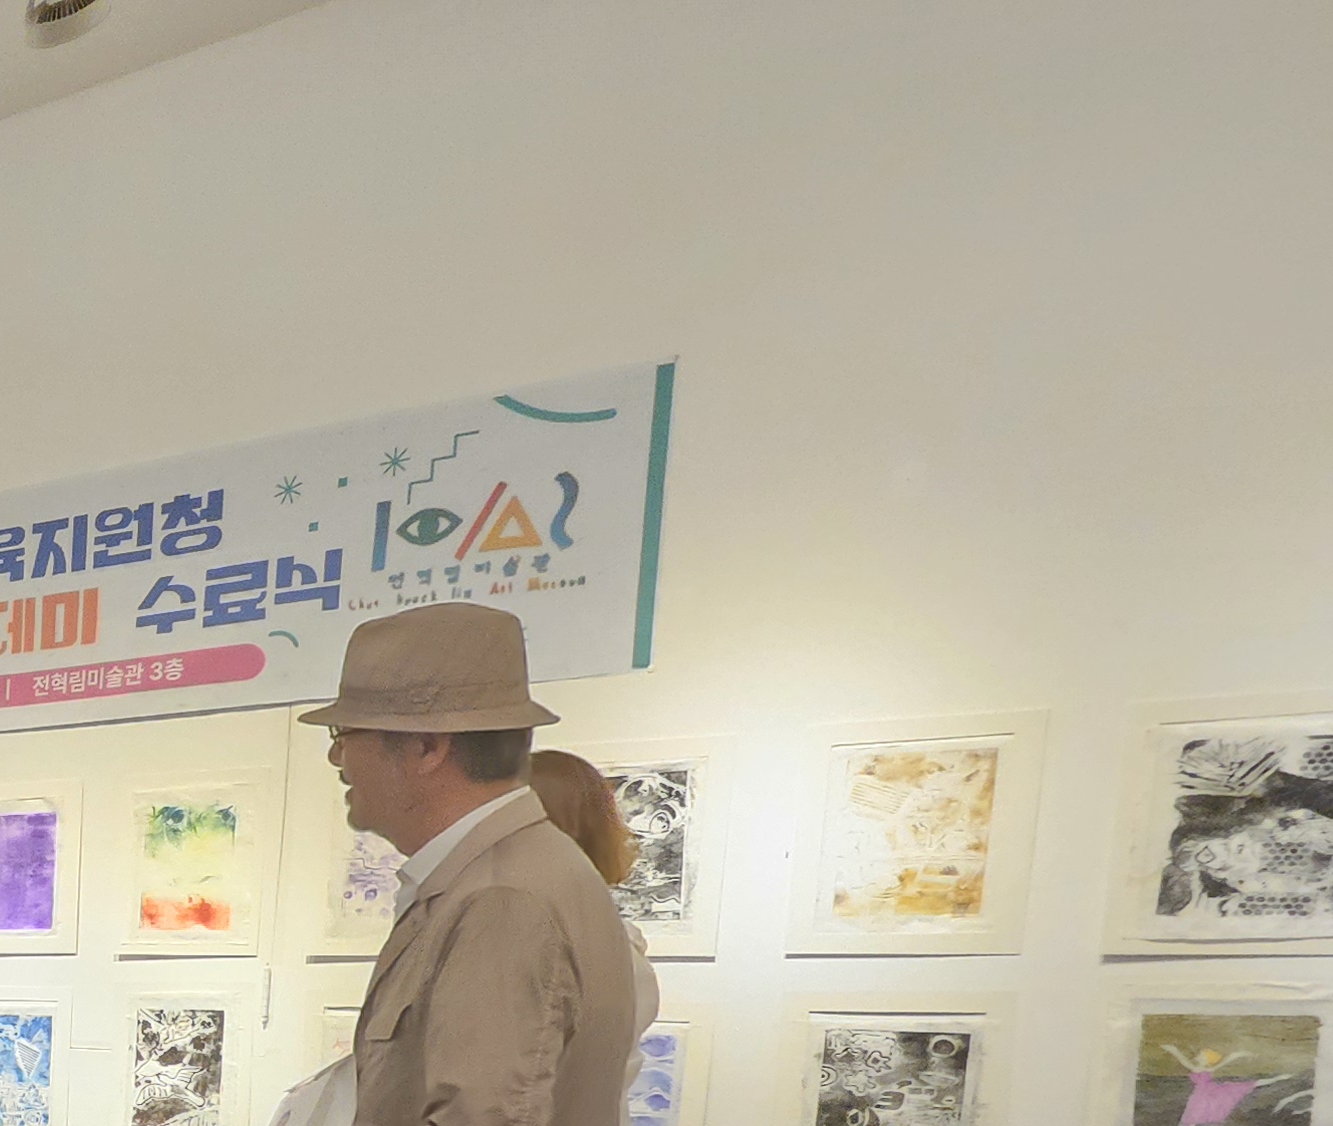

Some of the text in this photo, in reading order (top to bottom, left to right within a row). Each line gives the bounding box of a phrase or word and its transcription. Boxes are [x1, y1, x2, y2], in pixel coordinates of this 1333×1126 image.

[136, 549, 343, 635] 수료식
[32, 662, 145, 697] 전혁림미술관
[149, 657, 185, 682] 3층
